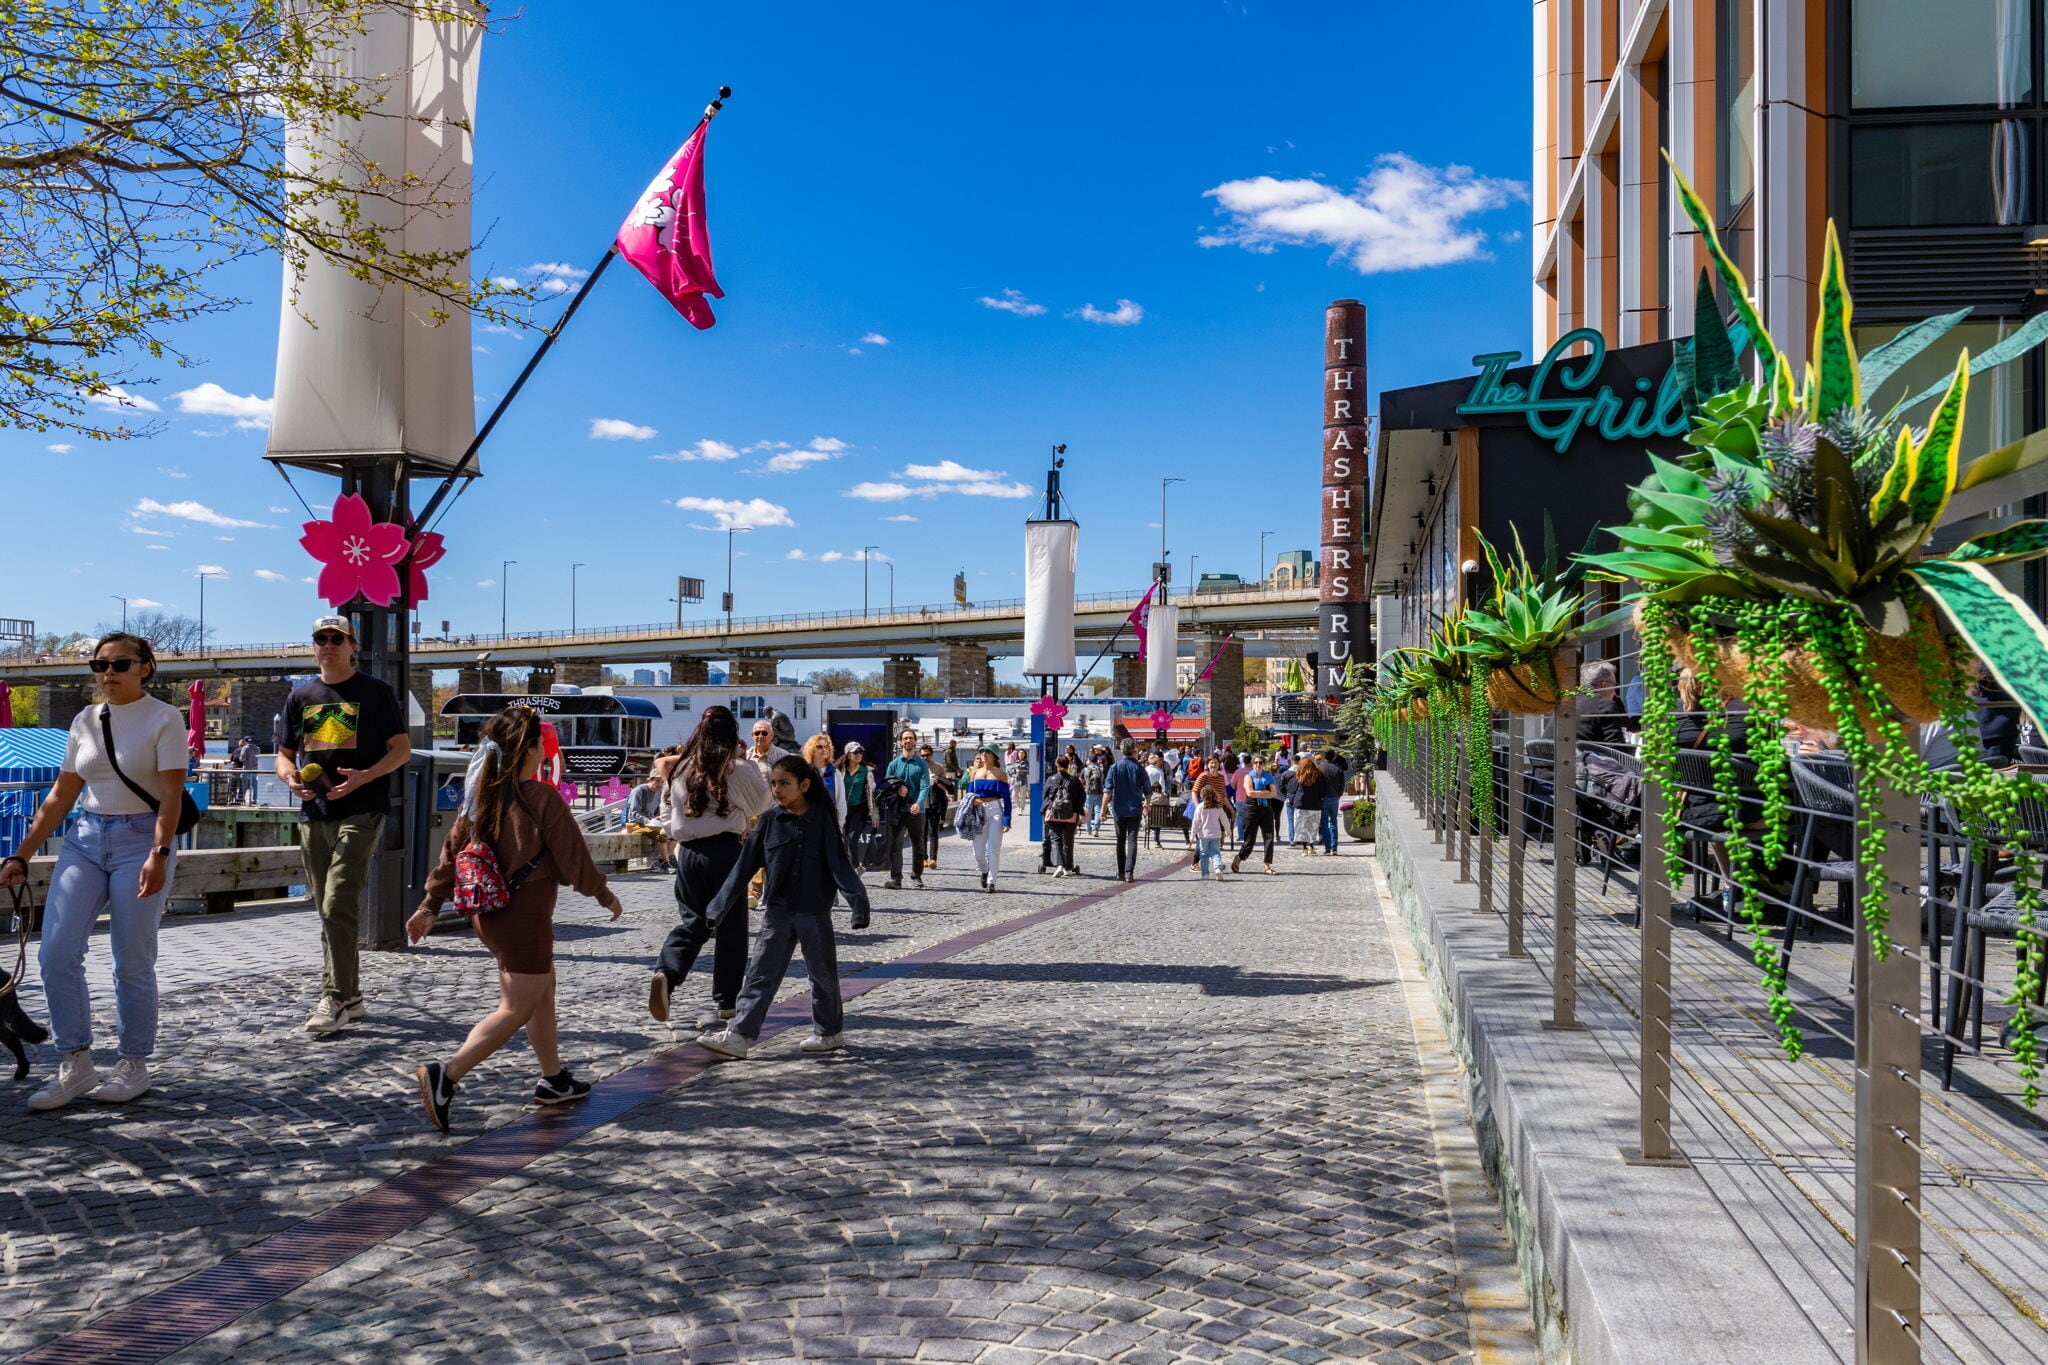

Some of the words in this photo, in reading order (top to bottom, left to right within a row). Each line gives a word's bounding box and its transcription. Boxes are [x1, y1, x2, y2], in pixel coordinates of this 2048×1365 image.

[1467, 350, 1527, 404] The
[1525, 327, 1750, 454] Gril
[1331, 338, 1353, 597] THRASHERS
[1328, 614, 1351, 687] RUM
